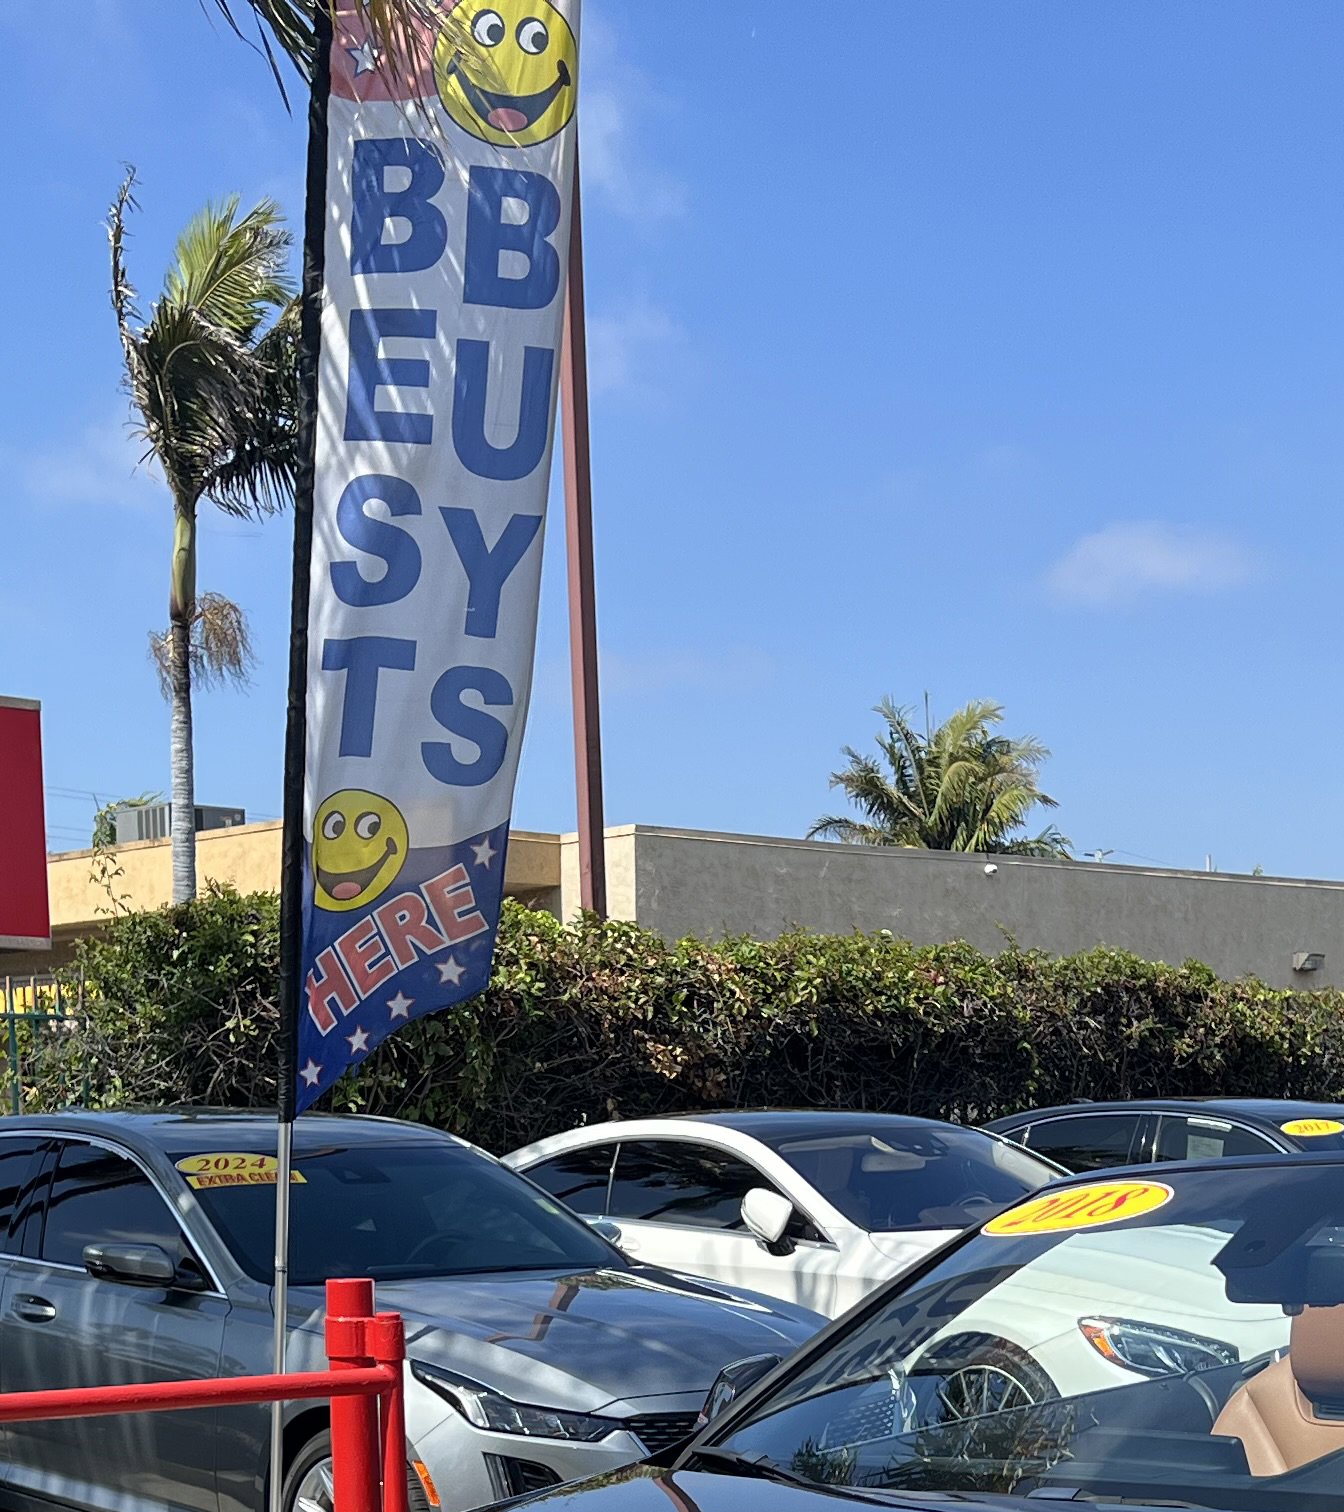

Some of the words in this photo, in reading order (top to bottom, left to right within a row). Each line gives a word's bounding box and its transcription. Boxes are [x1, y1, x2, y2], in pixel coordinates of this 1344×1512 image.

[321, 137, 448, 758] BEST
[420, 164, 561, 787] BUYS
[305, 862, 490, 1038] HERE
[196, 1156, 267, 1172] 2024
[196, 1173, 249, 1187] EXTRA
[249, 1170, 299, 1183] CLEN
[999, 1187, 1150, 1229] 2018
